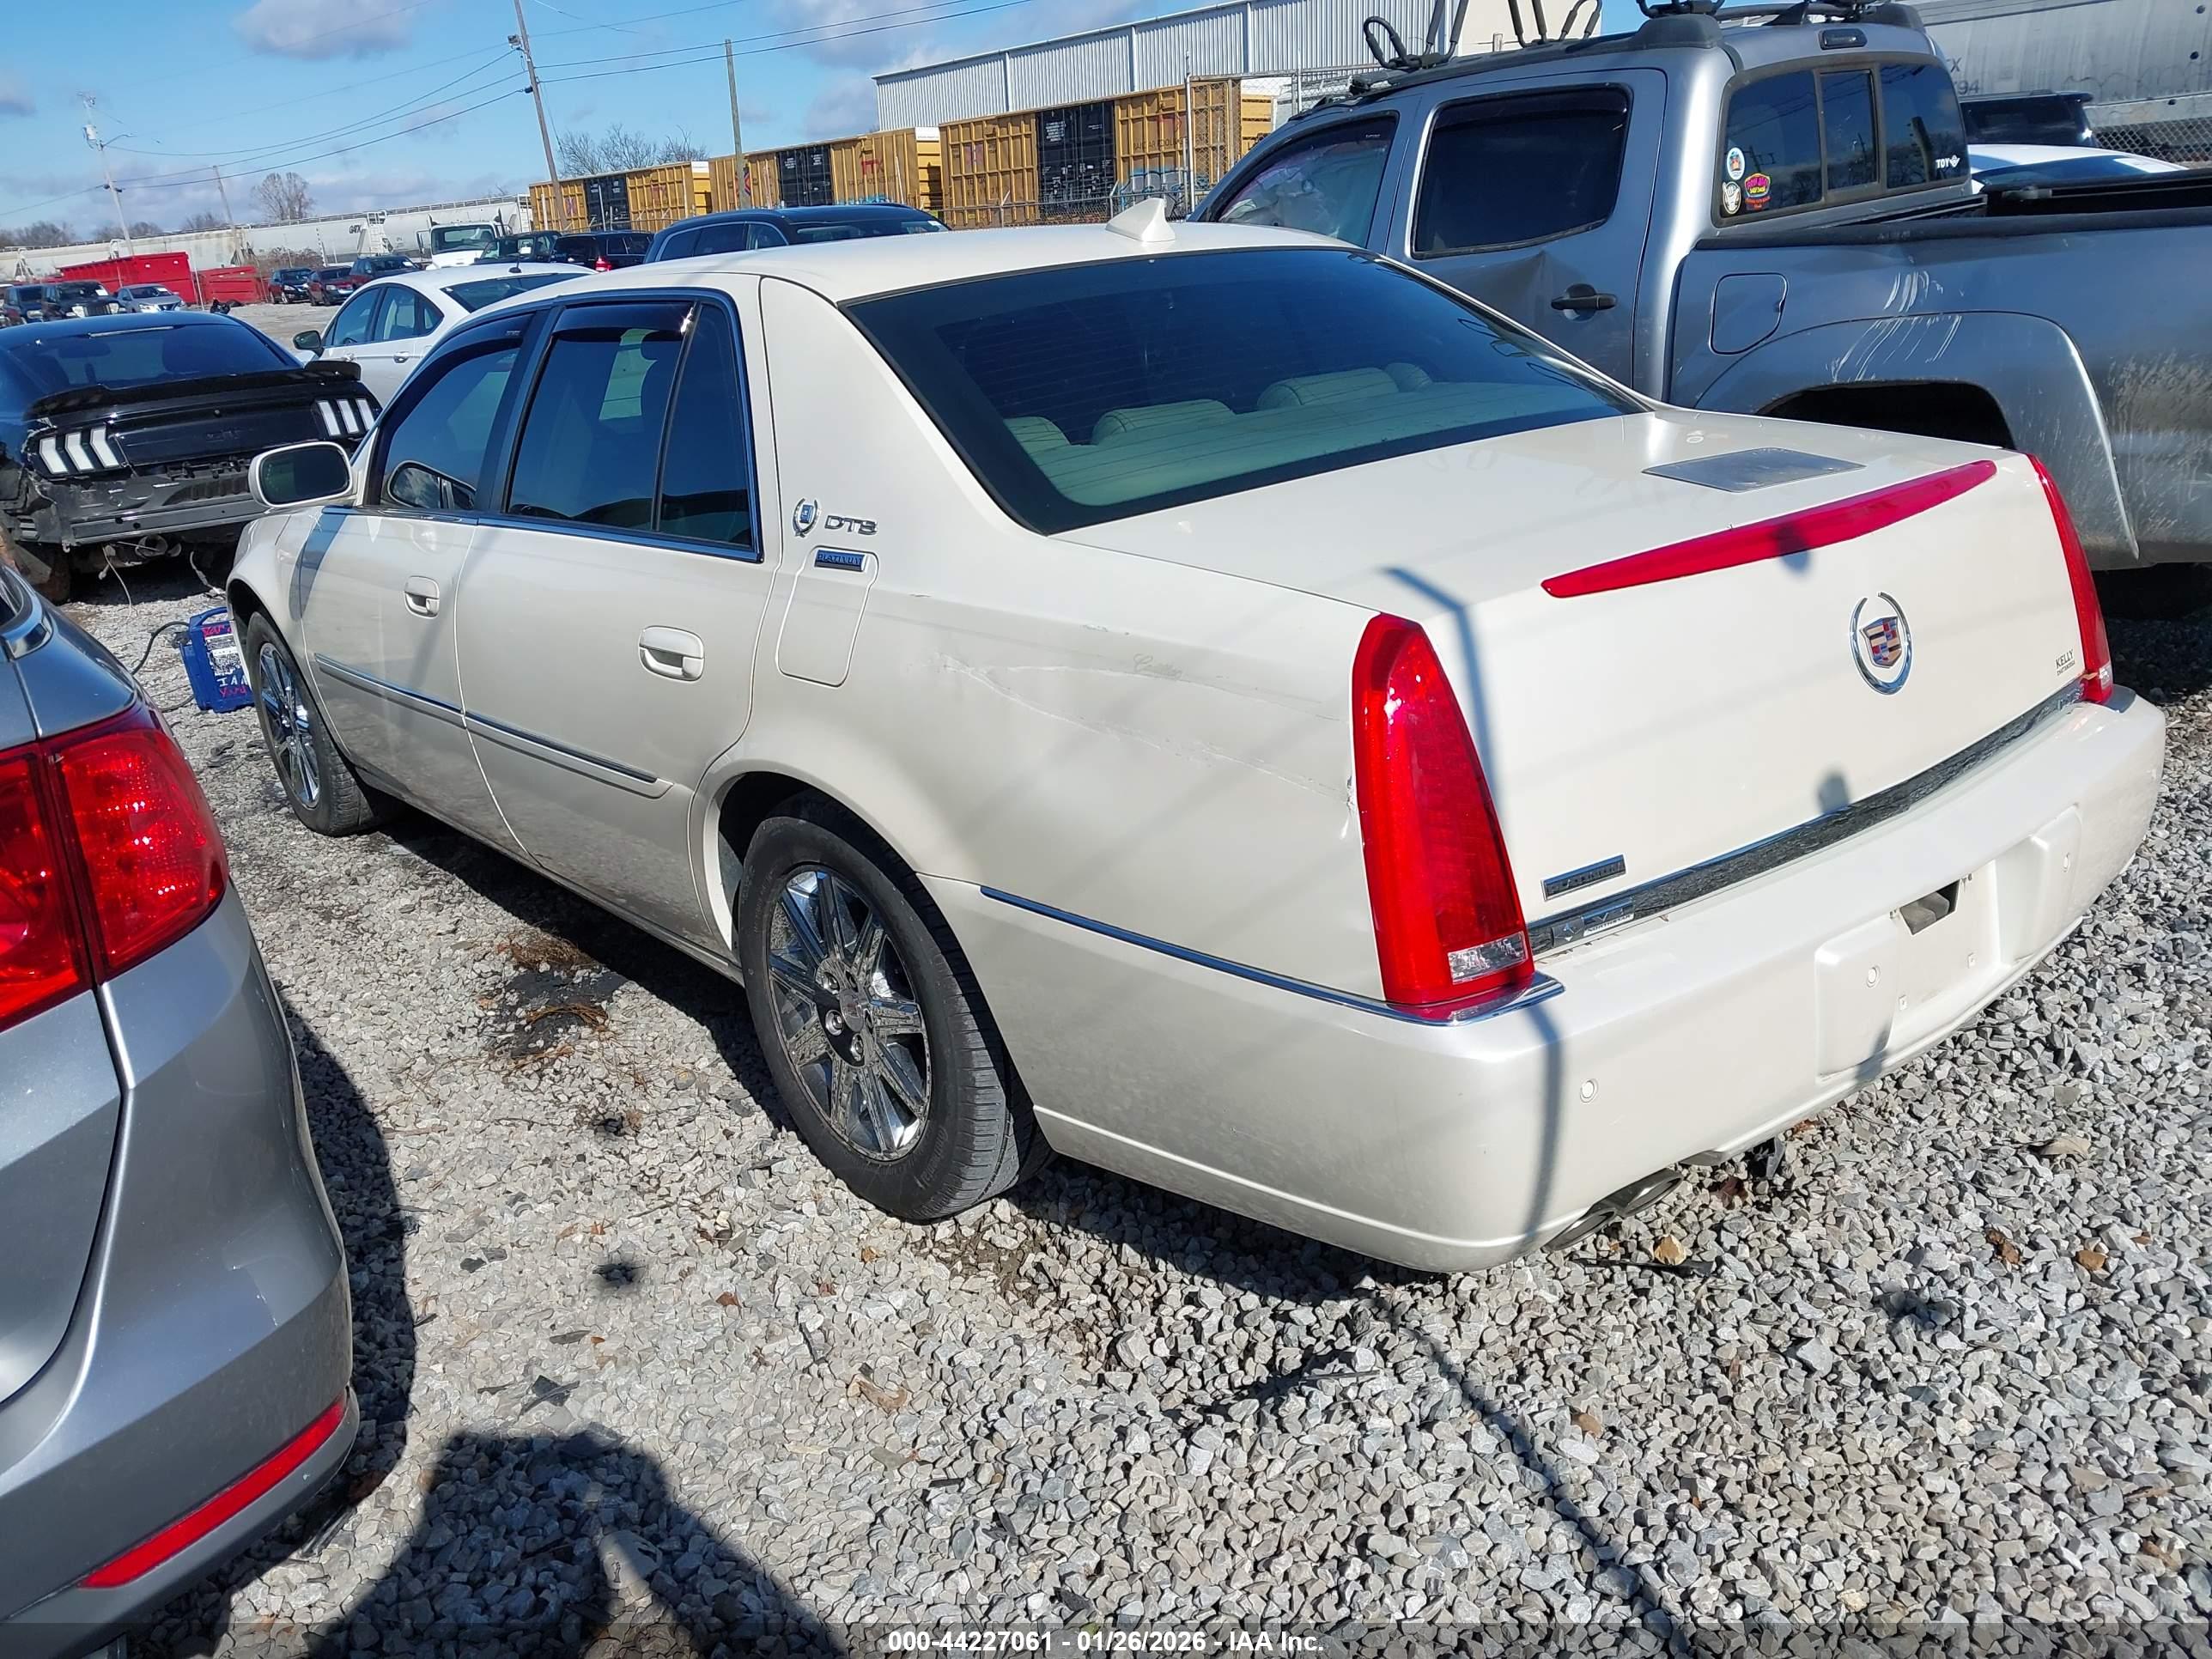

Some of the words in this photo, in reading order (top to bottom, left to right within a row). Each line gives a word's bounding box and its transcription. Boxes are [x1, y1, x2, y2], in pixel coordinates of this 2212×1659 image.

[824, 514, 878, 536] DTS
[817, 551, 863, 566] PLATINUM
[2055, 648, 2074, 670] KELLY
